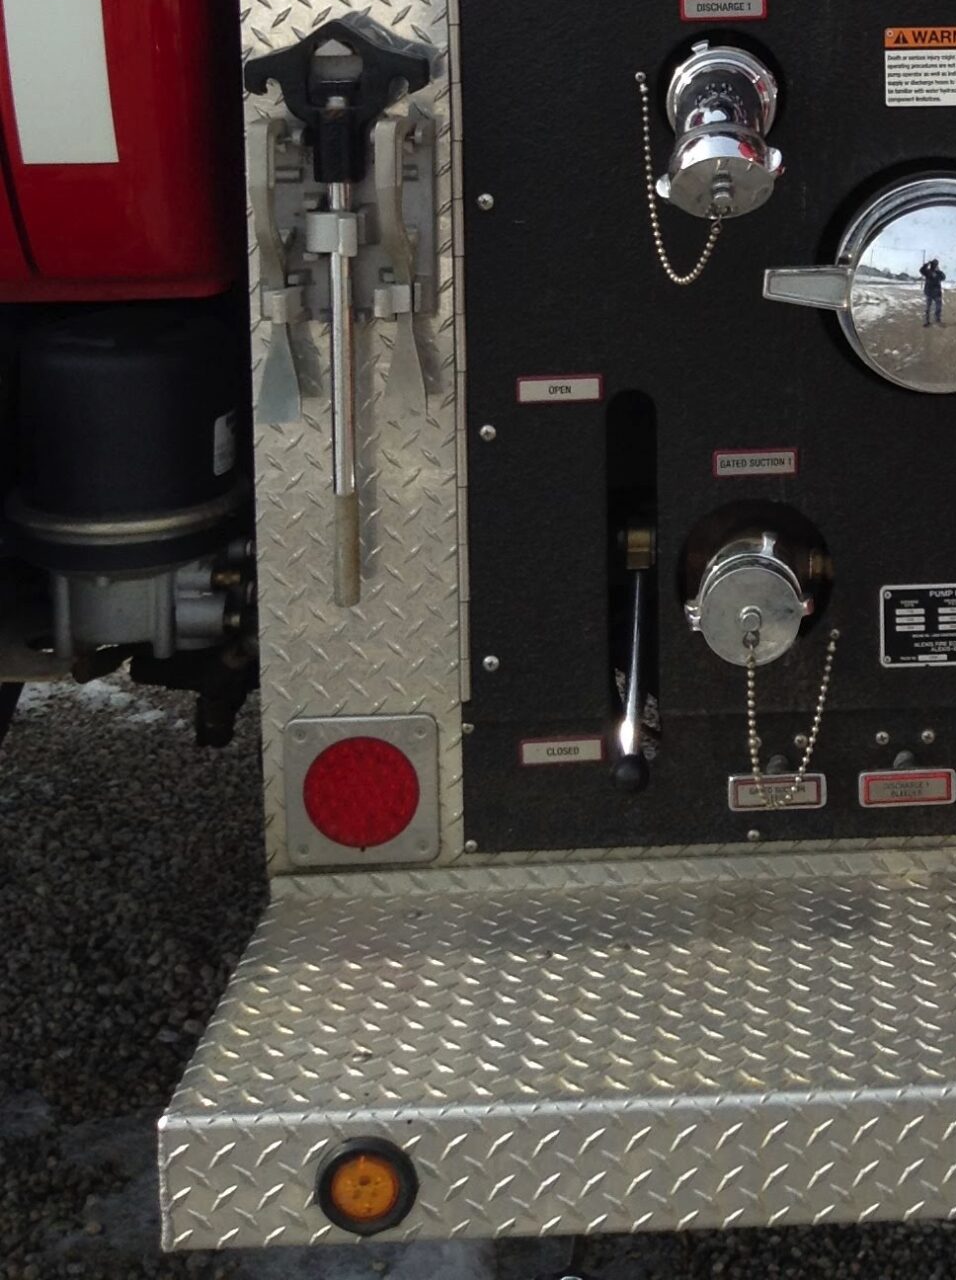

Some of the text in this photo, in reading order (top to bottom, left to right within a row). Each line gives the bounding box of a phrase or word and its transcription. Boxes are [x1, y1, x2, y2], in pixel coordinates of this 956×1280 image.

[697, 3, 744, 12] DISCHARGE
[548, 386, 571, 395] OPEN
[720, 460, 747, 468] GATED
[749, 458, 785, 467] SUCTION
[546, 747, 579, 756] CLOSED
